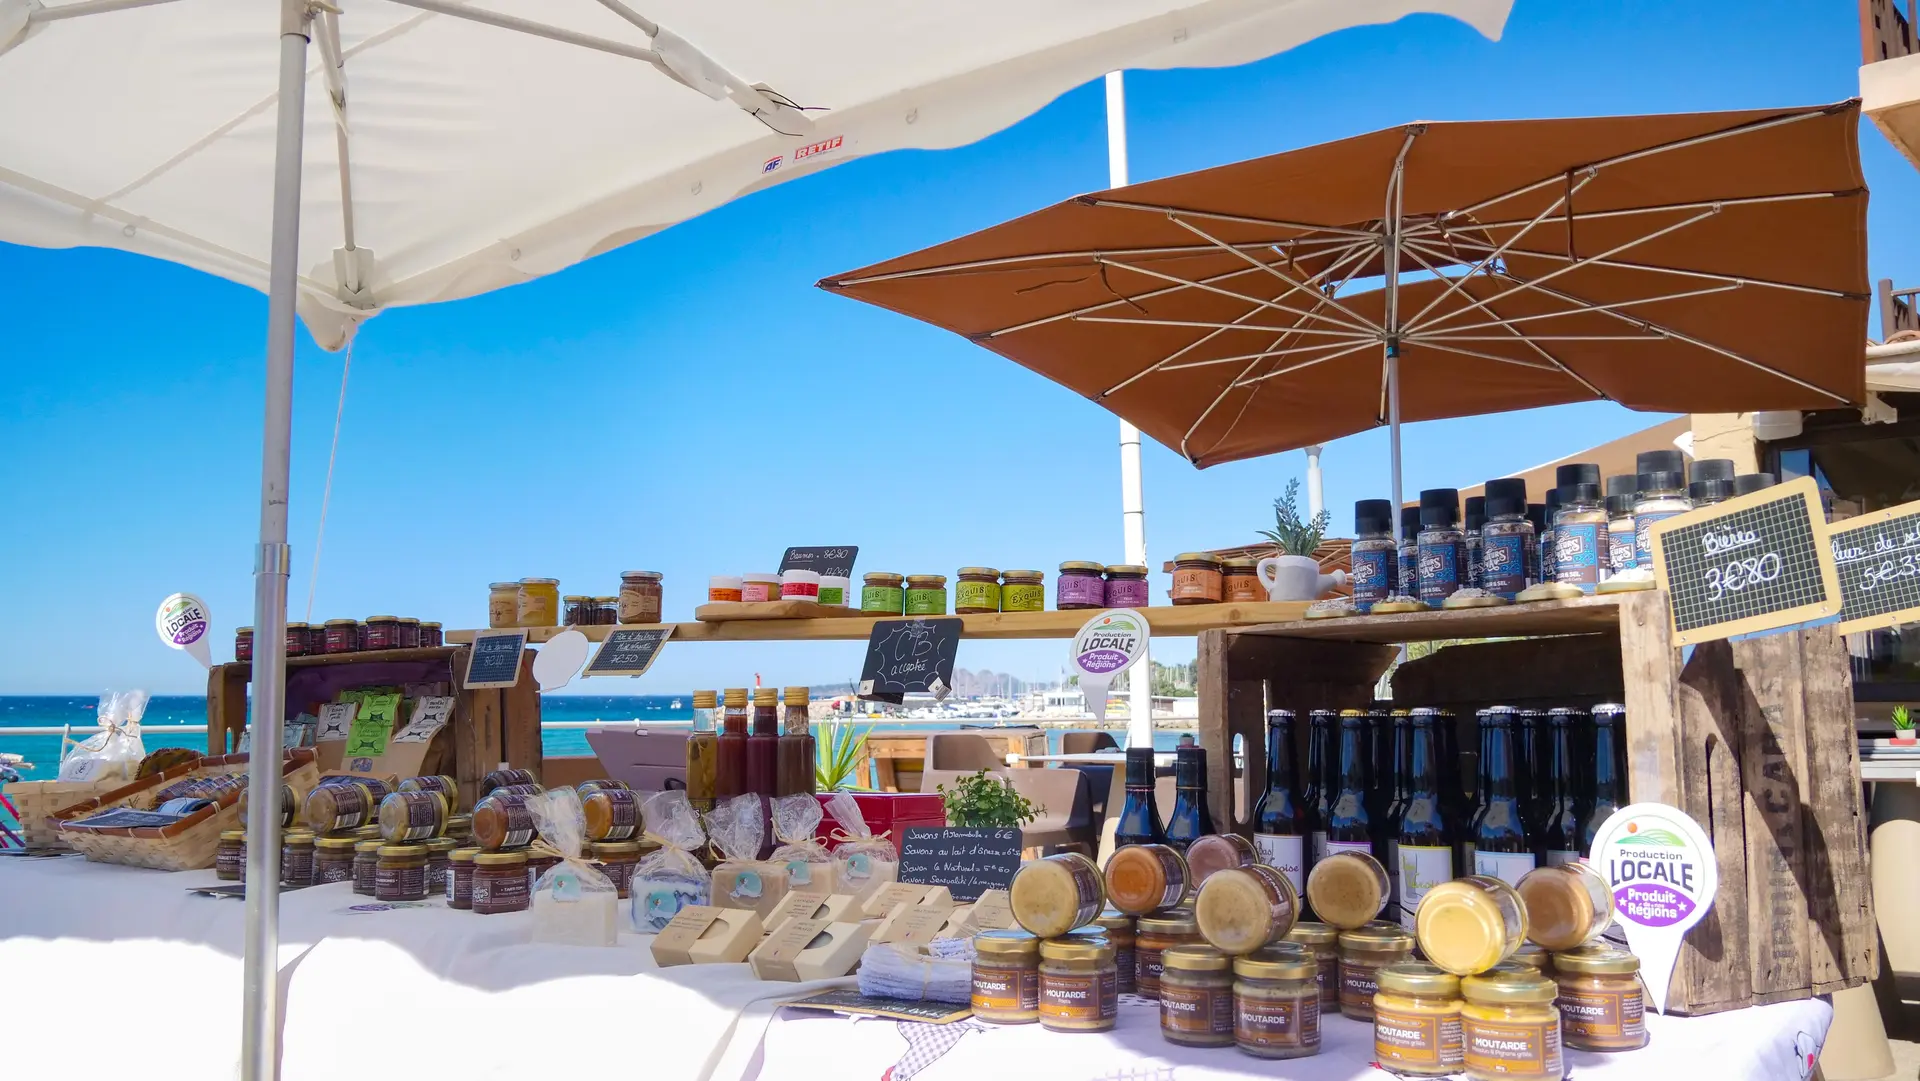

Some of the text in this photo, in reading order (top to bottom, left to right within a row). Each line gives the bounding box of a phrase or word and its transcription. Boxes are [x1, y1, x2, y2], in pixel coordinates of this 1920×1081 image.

[796, 136, 842, 159] RETIF
[764, 158, 781, 173] AF
[1702, 525, 1756, 553] Bières
[1831, 541, 1867, 561] leur
[1874, 532, 1896, 551] de
[1704, 553, 1780, 601] 3€80
[166, 608, 203, 637] LOCALE
[894, 630, 933, 661] CB
[1081, 637, 1136, 654] LOCALE
[1086, 660, 1117, 670] Régions
[904, 844, 933, 855] Savons
[1620, 849, 1683, 860] Production
[1610, 859, 1694, 893] LOCALE
[1627, 888, 1677, 904] Produit
[1627, 902, 1678, 919] Régions
[973, 979, 1006, 991] MOUTARDE
[1046, 988, 1086, 999] MOUTARDE
[1160, 998, 1196, 1012] MOUTARDE
[1560, 1003, 1605, 1016] MOUTARDE
[1241, 1012, 1285, 1024] MOUTARDE
[1378, 1024, 1420, 1040] MOUTARDE
[1475, 1037, 1527, 1050] MOUTARDE
